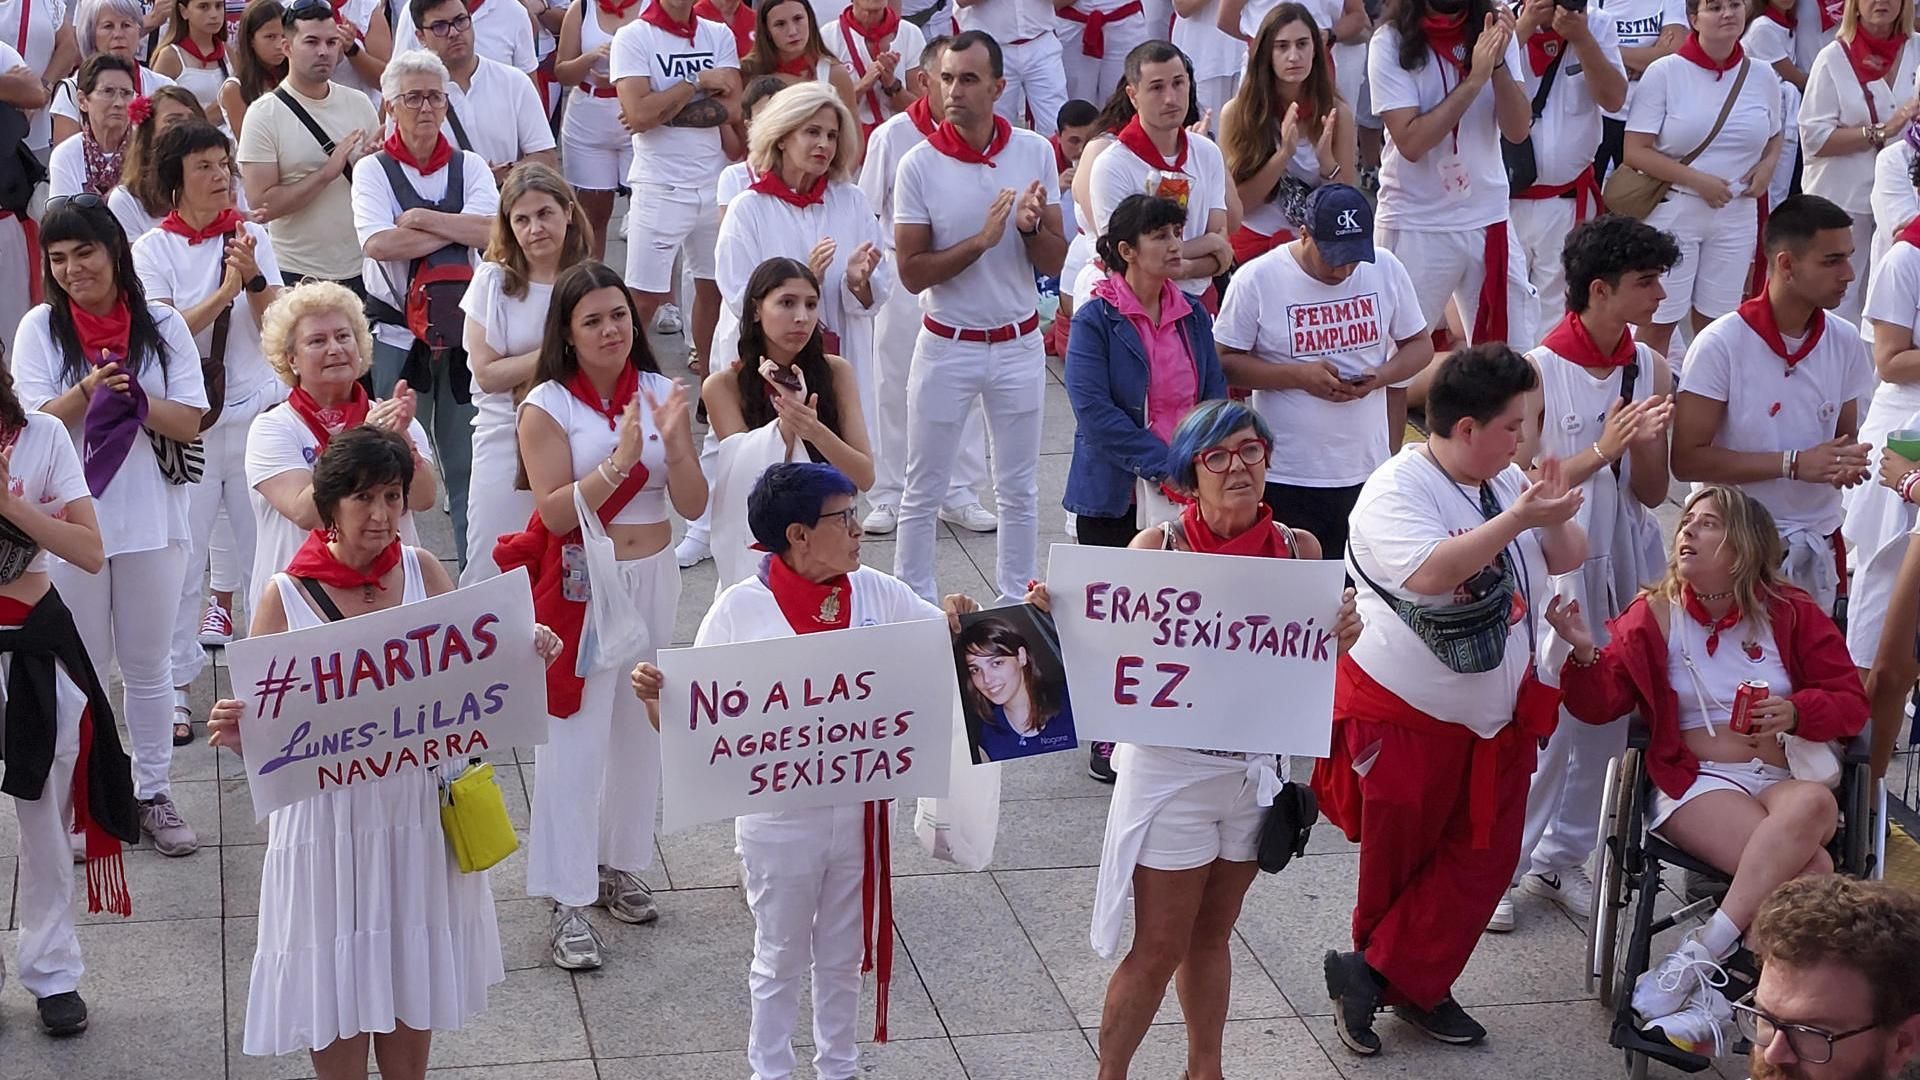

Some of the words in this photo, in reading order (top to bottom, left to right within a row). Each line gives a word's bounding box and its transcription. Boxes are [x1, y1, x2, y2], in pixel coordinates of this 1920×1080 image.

[656, 52, 714, 77] VANS
[1294, 320, 1378, 353] PAMPLONA
[1085, 581, 1202, 623] ERASO
[254, 613, 499, 719] #-HARTAS
[1113, 655, 1193, 708] EZ.
[762, 680, 789, 713] A
[803, 670, 876, 706] LAS
[317, 729, 488, 789] NAVARRA
